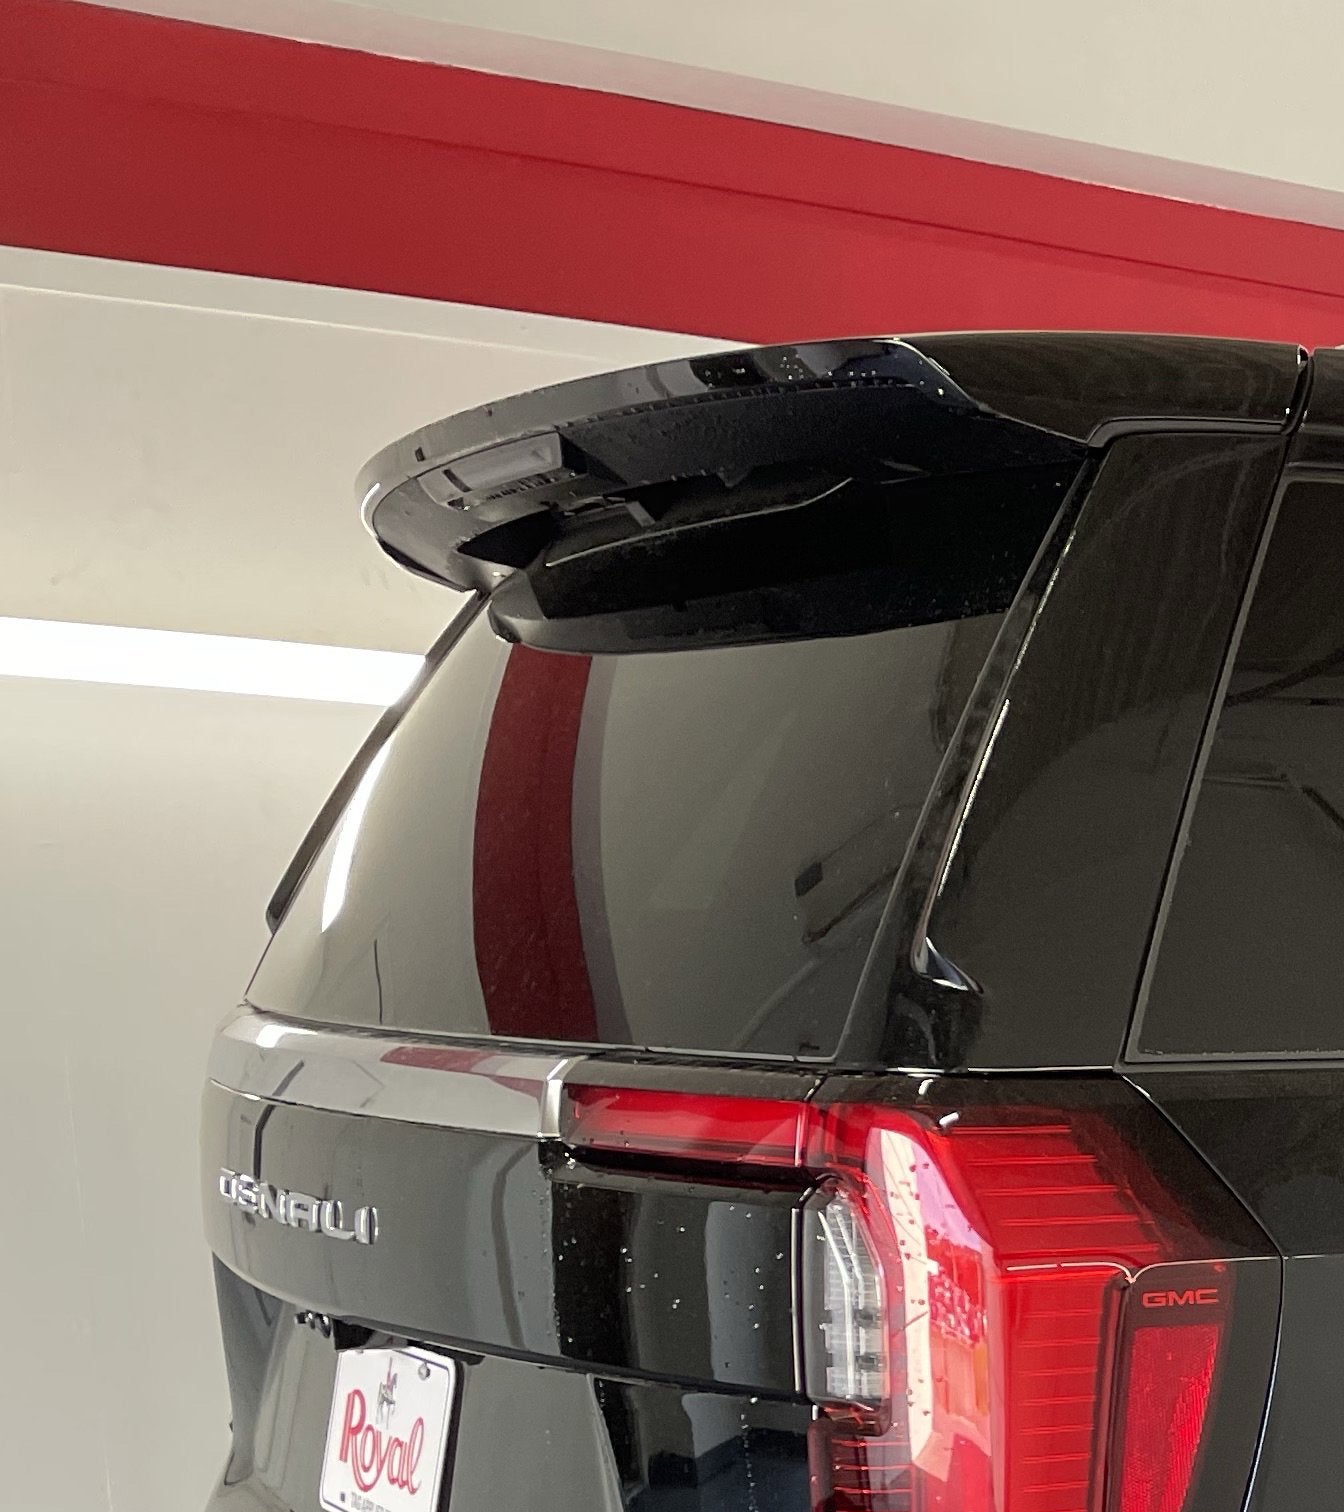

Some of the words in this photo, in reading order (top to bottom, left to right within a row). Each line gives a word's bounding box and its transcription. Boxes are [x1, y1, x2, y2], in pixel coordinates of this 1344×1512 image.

[219, 1167, 379, 1245] DENALI
[1142, 1288, 1219, 1308] GMC
[339, 1389, 425, 1495] Royal
